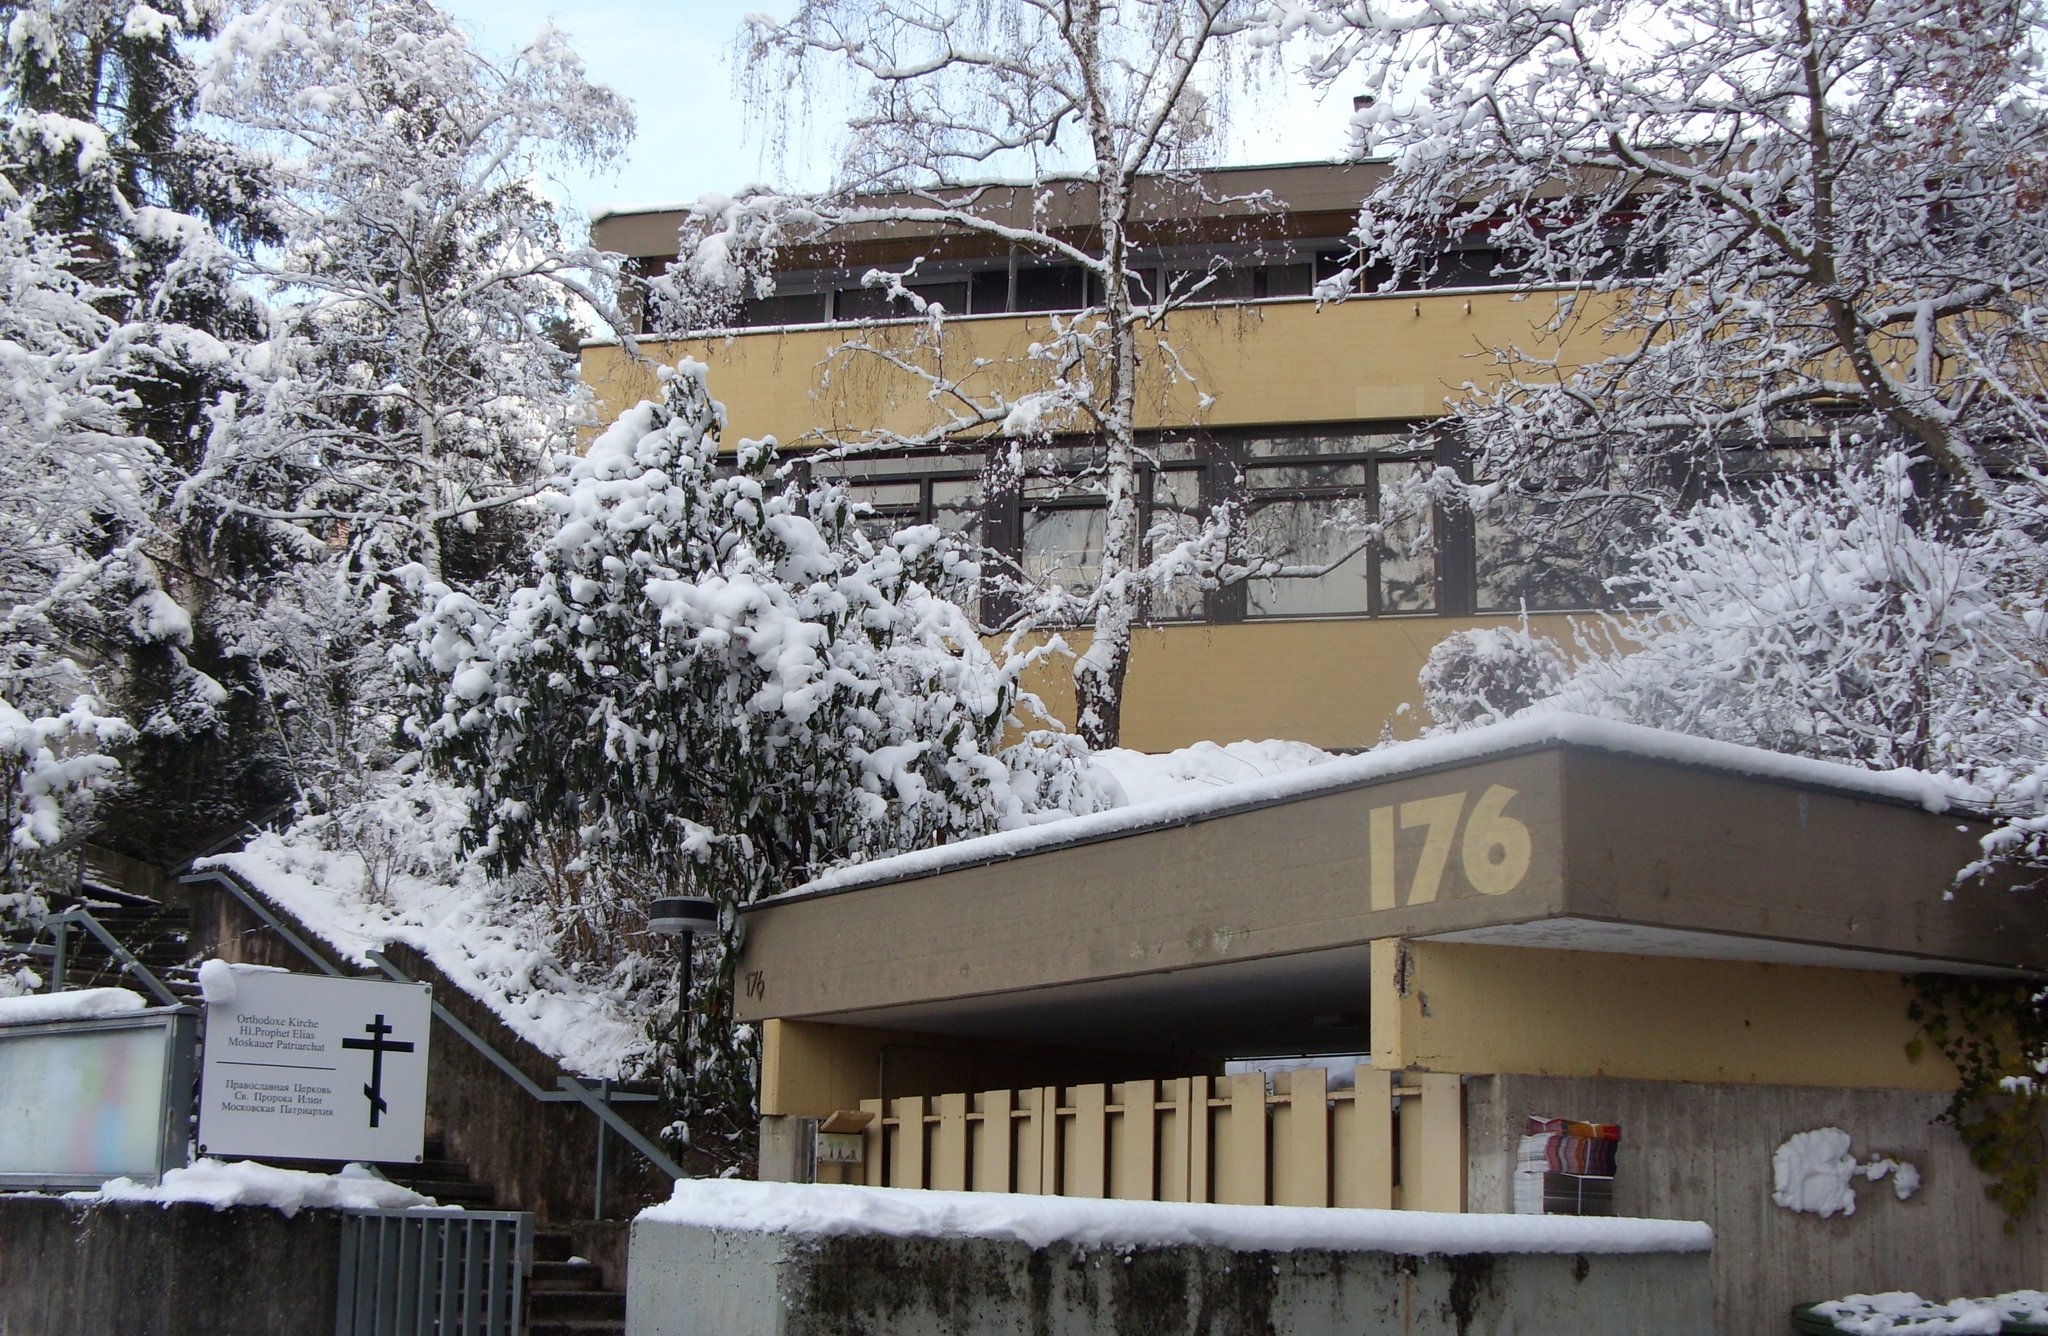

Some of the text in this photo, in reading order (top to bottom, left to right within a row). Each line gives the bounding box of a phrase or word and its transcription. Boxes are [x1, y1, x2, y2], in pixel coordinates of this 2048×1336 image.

[1369, 783, 1532, 912] 176
[745, 970, 766, 1002] 176
[237, 1014, 319, 1029] Orthodoxe Kirche
[293, 1029, 315, 1040] Elias
[228, 1037, 325, 1052] Moskauer Patriarchat
[226, 1080, 332, 1095] Православная Церковь
[234, 1091, 322, 1105] Св. Пророка Илии
[221, 1102, 334, 1116] Московская Патриархия
